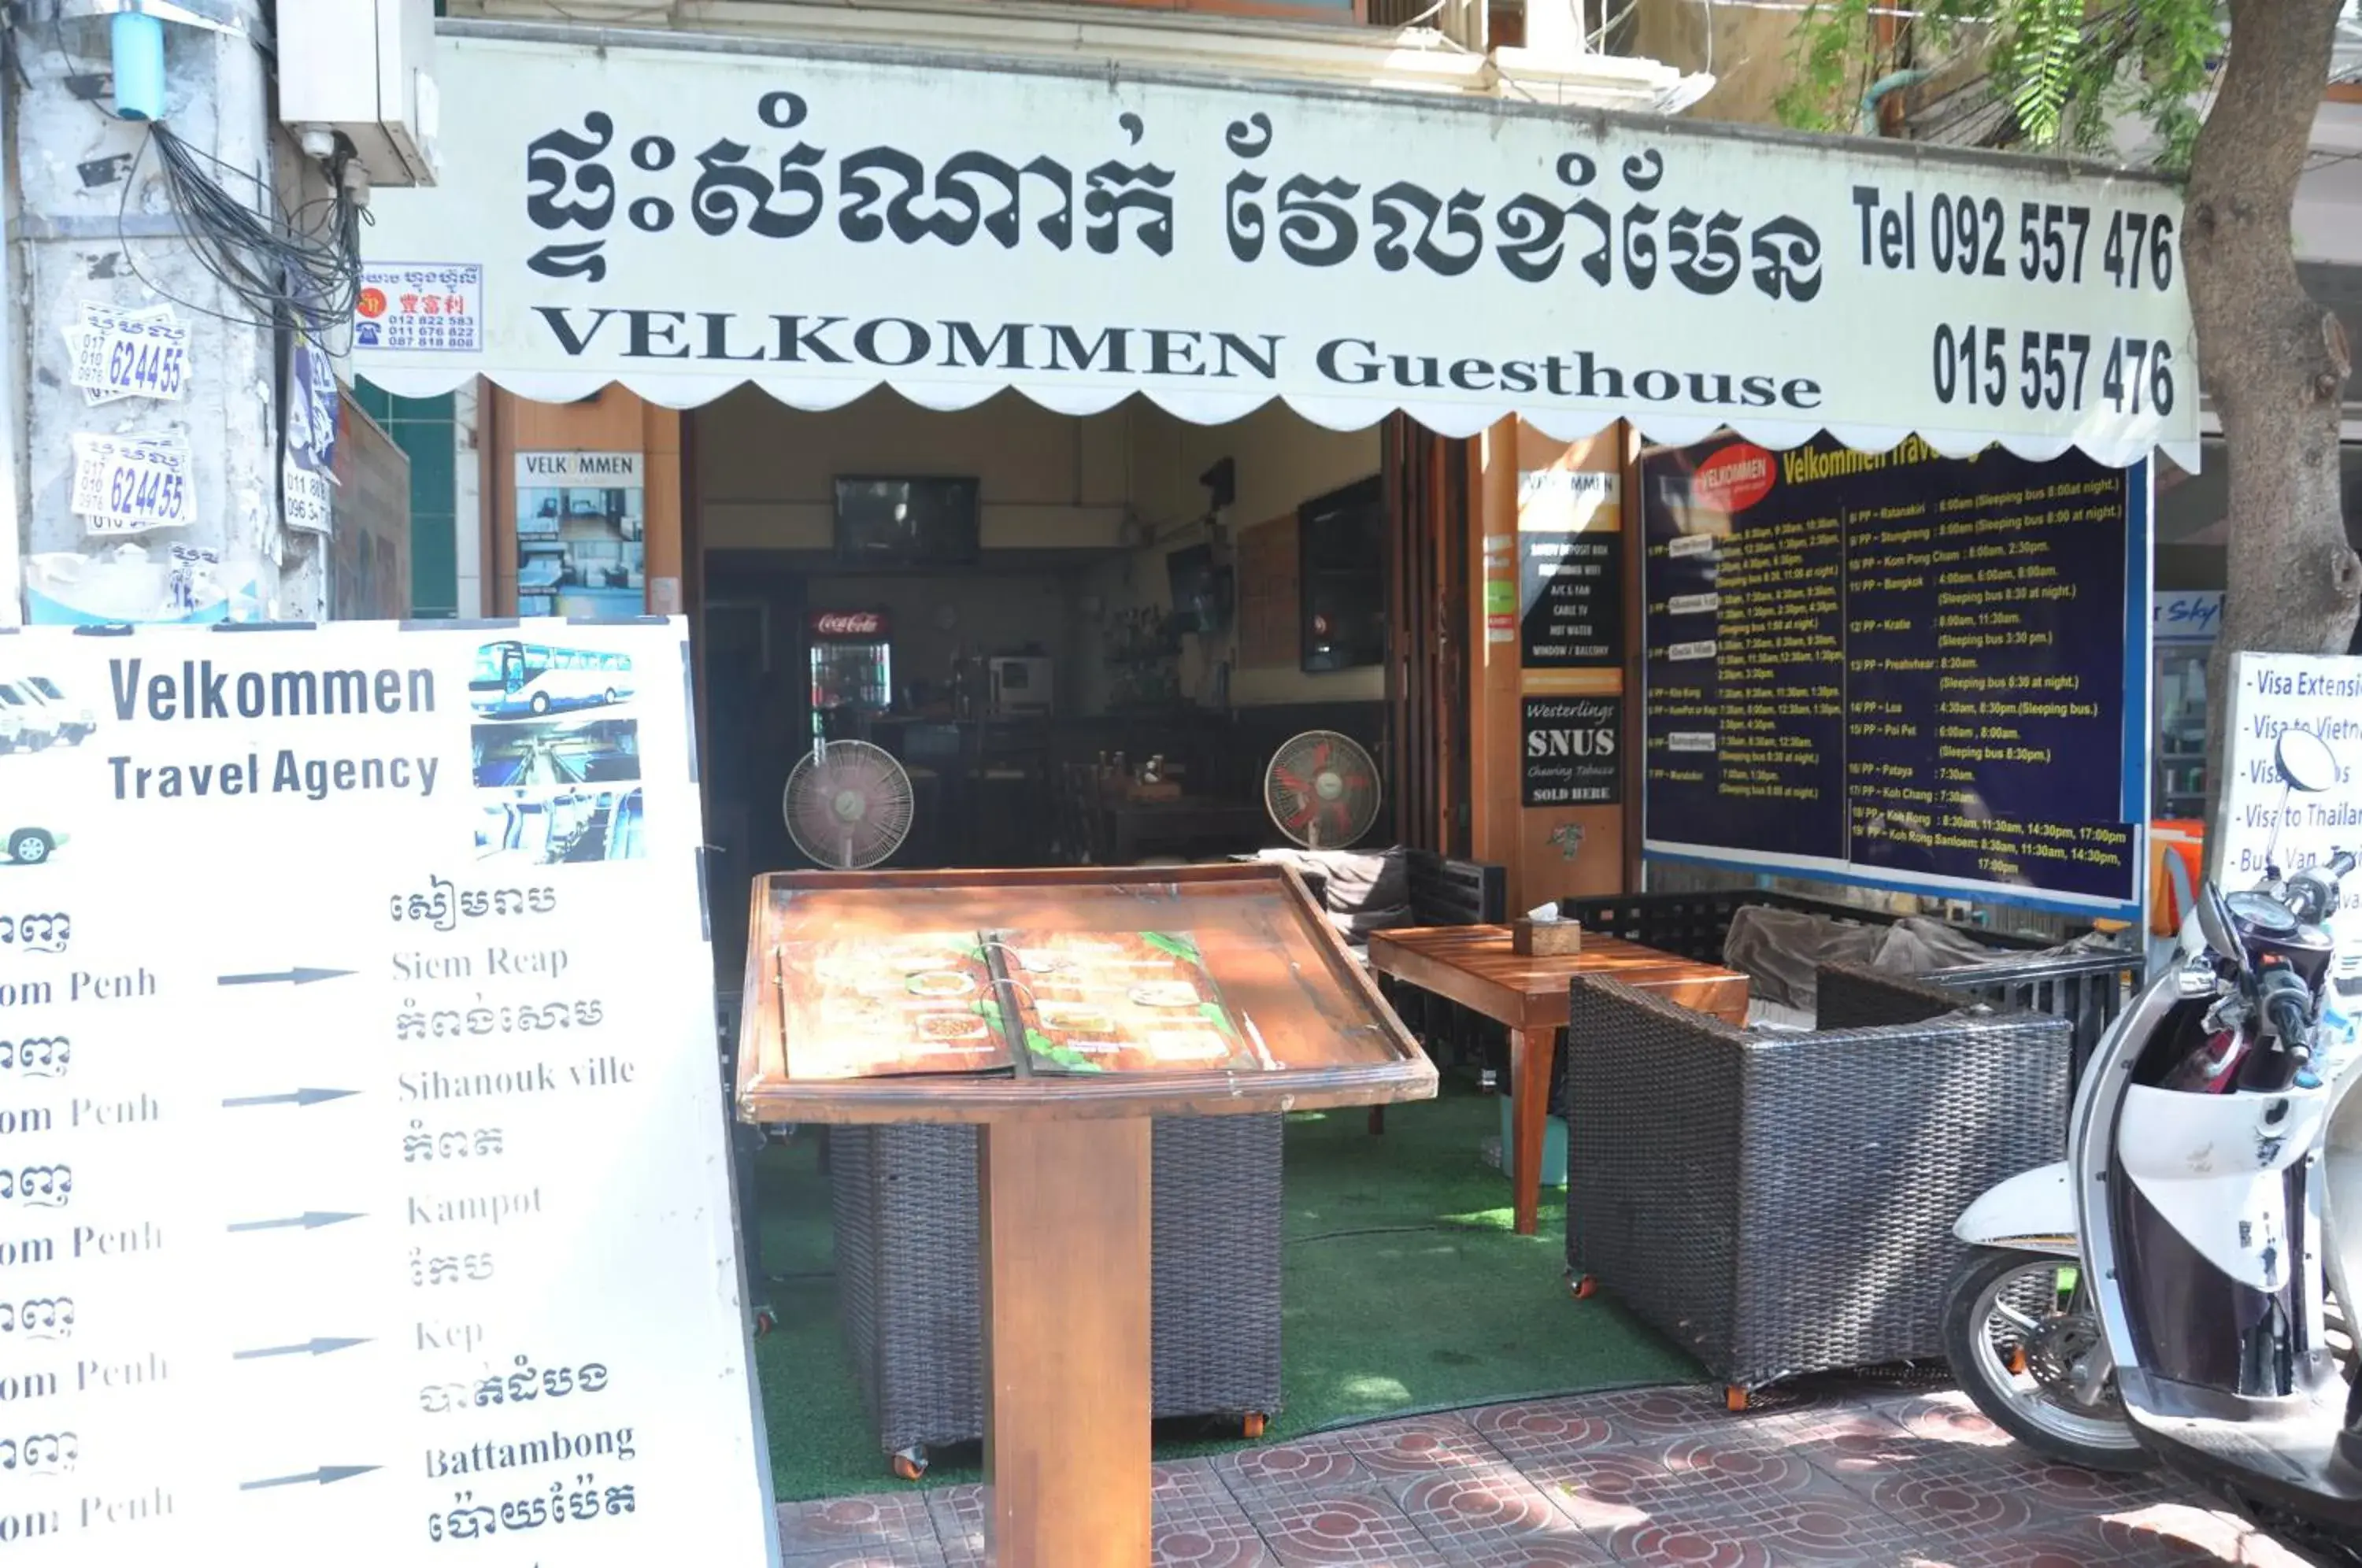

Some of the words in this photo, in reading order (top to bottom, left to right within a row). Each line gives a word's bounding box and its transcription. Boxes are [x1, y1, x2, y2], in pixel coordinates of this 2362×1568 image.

[527, 91, 1175, 283] ផ្ទះសំណាក់
[1853, 186, 1915, 269] Tel
[1931, 193, 2006, 276] 092
[2020, 202, 2090, 283] 557
[2103, 209, 2174, 291] 476
[388, 316, 414, 324] 012
[419, 316, 444, 325] 822
[388, 326, 413, 335] 011
[531, 305, 1285, 380] VELKOMMEN
[1316, 337, 1823, 410] Guesthouse
[1933, 324, 2007, 407] 015
[2020, 331, 2091, 411] 557
[2103, 337, 2174, 416] 476
[527, 456, 633, 473] VELKOMMEN
[1783, 445, 1886, 484] Velkommen
[1893, 435, 1942, 465] Trav
[1702, 459, 1767, 491] VELKOMMEN
[111, 466, 183, 518] 624455
[1859, 510, 1871, 522] PP
[2025, 487, 2045, 501] bus
[1859, 533, 1871, 545] PP
[2024, 514, 2044, 526] bus
[2072, 509, 2083, 522] at
[2086, 504, 2122, 522] night.)
[1862, 557, 1875, 570] PP
[1863, 579, 1875, 591] PP
[1985, 589, 2004, 601] bus
[2028, 587, 2040, 599] at
[2042, 583, 2077, 601] night.)
[1864, 619, 1875, 631] PP
[1985, 634, 2004, 645] bus
[1864, 659, 1876, 671] PP
[109, 658, 435, 722] Velkommen
[1987, 675, 2006, 687] bus
[2031, 675, 2042, 686] at
[2045, 674, 2079, 691] night.)
[2257, 669, 2292, 695] Visa
[2297, 671, 2362, 697] Extensi
[1864, 701, 1876, 712] PP
[1527, 728, 1615, 757] SNUS
[1864, 723, 1876, 736] PP
[1985, 746, 2004, 760] bus
[108, 753, 258, 800] Travel
[272, 750, 439, 801] Agency
[1862, 763, 1875, 775] PP
[1534, 787, 1569, 801] SOLD
[1572, 786, 1611, 801] HERE
[1862, 785, 1875, 797] PP
[1902, 788, 1933, 804] Chang
[1865, 807, 1878, 818] PP
[2028, 823, 2076, 840] 14:30pm,
[2079, 827, 2127, 845] 17:00pm
[2286, 805, 2301, 827] to
[1908, 830, 1933, 847] Rong
[2021, 842, 2068, 860] 11:30am,
[2071, 848, 2121, 867] 14:30pm,
[392, 950, 472, 982] Siem
[487, 947, 568, 979] Reap
[71, 967, 156, 1002] Penh
[398, 1061, 556, 1102] Sihanouk
[569, 1056, 635, 1085] ville
[72, 1092, 158, 1127] Penh
[74, 1221, 161, 1259] Penh
[425, 1427, 636, 1479] Battambong
